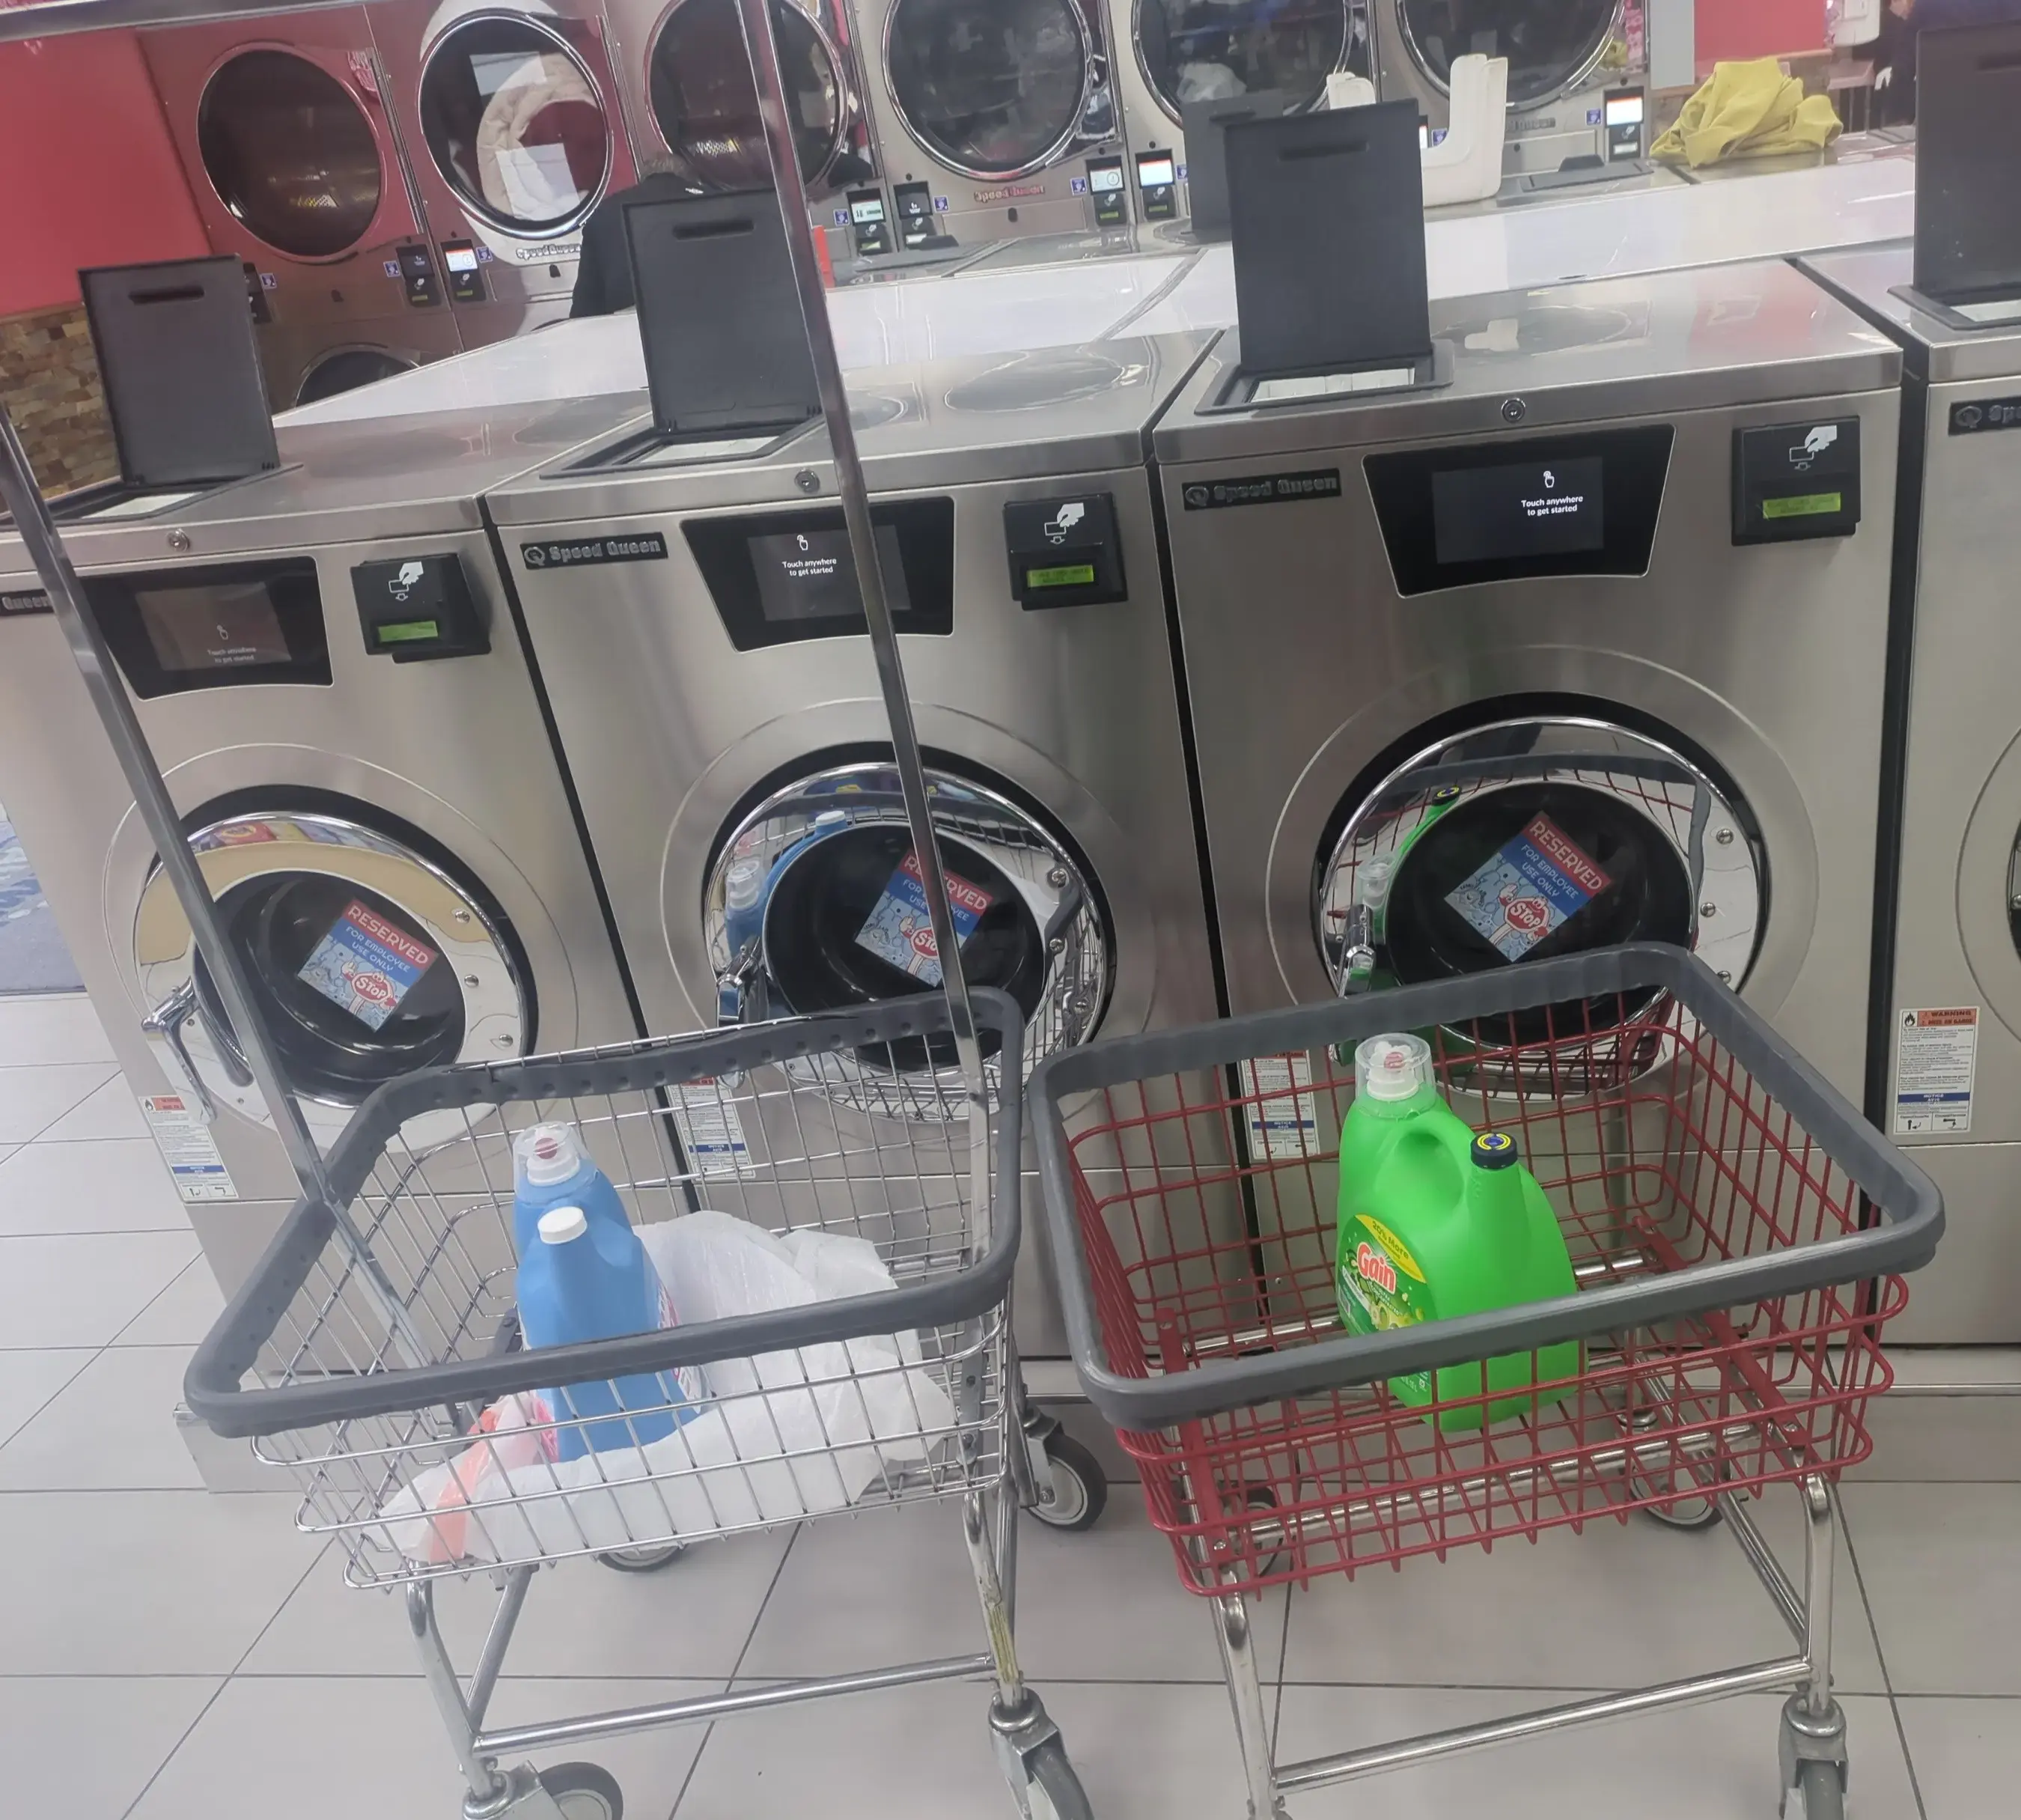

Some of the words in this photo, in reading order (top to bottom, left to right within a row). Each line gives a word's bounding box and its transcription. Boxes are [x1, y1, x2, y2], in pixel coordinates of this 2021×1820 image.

[1213, 481, 1272, 503] Speed
[1277, 477, 1337, 494] Queen
[1521, 499, 1544, 508] Touch
[1546, 496, 1583, 505] anywhere
[1537, 507, 1549, 517] get
[1551, 504, 1577, 514] started
[549, 543, 603, 562] Speed
[606, 540, 661, 556] Queen
[781, 560, 803, 568] Touch
[805, 558, 837, 567] anywhere
[798, 568, 809, 576] get
[810, 566, 833, 575] started
[1529, 821, 1603, 890] RESERVED
[1521, 844, 1540, 862] FOR
[1537, 859, 1579, 899] EMPLOYEE
[1522, 862, 1540, 879] USE
[1537, 878, 1560, 898] ONLY
[903, 878, 921, 893] FOR
[1510, 902, 1541, 928] STOP
[347, 904, 429, 964] RESERVED
[345, 925, 364, 943] FOR
[365, 939, 411, 973] EMPLOYEE
[351, 941, 369, 958] USE
[369, 955, 394, 972] ONLY
[355, 976, 387, 999] STOP
[1388, 1236, 1409, 1259] More
[1357, 1241, 1396, 1294] Gain
